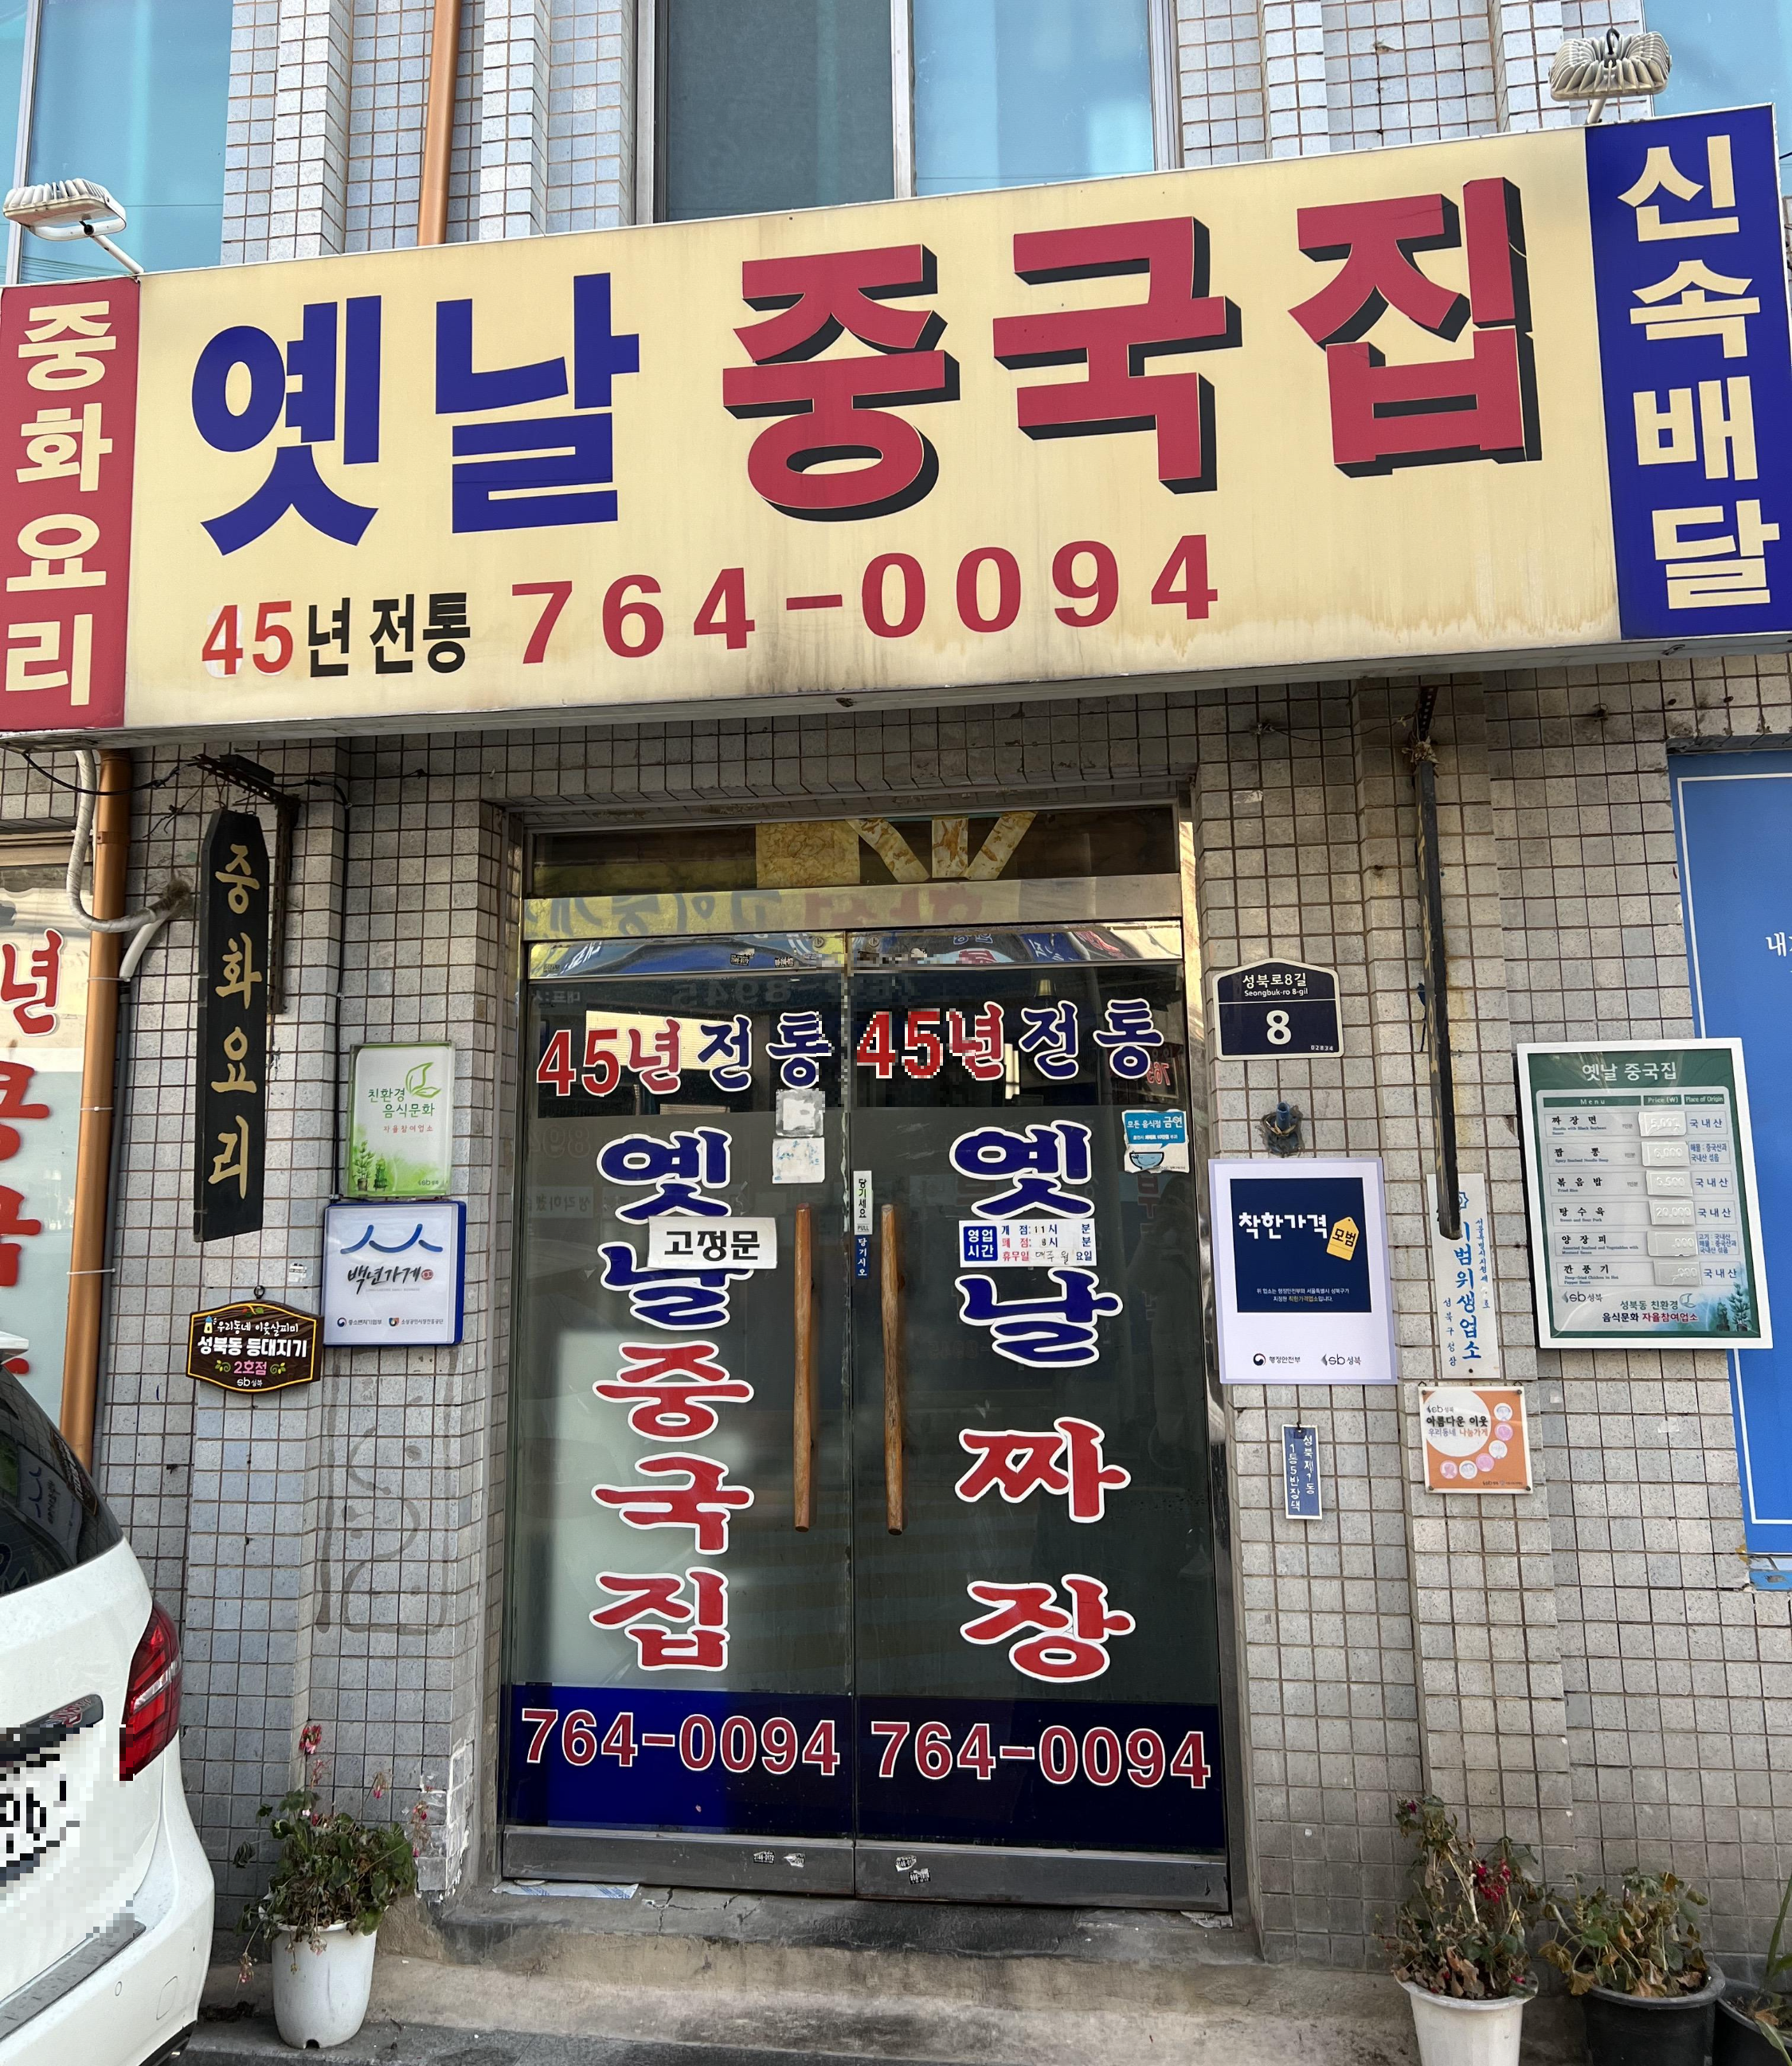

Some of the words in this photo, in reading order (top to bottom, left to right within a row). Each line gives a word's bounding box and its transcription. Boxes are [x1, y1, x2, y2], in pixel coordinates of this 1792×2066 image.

[191, 272, 640, 556] 옛날
[723, 177, 1542, 522] 중국집
[1617, 135, 1779, 608] 신속배달
[6, 300, 117, 706] 중화요리
[202, 597, 350, 678] 45년
[372, 592, 471, 675] 전통
[512, 534, 1218, 663] 764-0094
[1765, 932, 1792, 957] 내
[1242, 972, 1307, 989] 성북로8길
[208, 844, 264, 1199] 중화요리
[1266, 1010, 1292, 1045] 8
[857, 1000, 1005, 1082] 45년
[1019, 998, 1165, 1080] 전통
[535, 1017, 681, 1097] 45년
[697, 1011, 833, 1093] 전통
[1583, 1063, 1618, 1082] 옛날
[1624, 1062, 1677, 1080] 중국집
[368, 1088, 405, 1103] 친환경
[382, 1103, 435, 1119] 음식문화
[1127, 1120, 1141, 1129] 모든
[1142, 1120, 1161, 1129] 음식점
[1163, 1116, 1183, 1129] 금연
[1551, 1115, 1597, 1125] 짜장면
[1690, 1119, 1722, 1128] 국내산
[383, 1124, 434, 1133] 자율참여업소
[1557, 1177, 1602, 1187] 볶음밥
[1695, 1178, 1728, 1188] 국내산
[859, 1179, 867, 1218] 당기세요
[1559, 1207, 1605, 1216] 탕수육
[1697, 1208, 1731, 1218] 국내산
[597, 1126, 754, 1331] 옛날
[1082, 1224, 1091, 1234] 분
[1238, 1211, 1328, 1239] 착한가격
[968, 1229, 993, 1242] 영업
[1082, 1237, 1091, 1247] 분
[1332, 1228, 1357, 1247] 모범
[1562, 1235, 1606, 1244] 양장피
[664, 1230, 761, 1262] 고정문
[949, 1120, 1124, 1368] 옛날
[968, 1245, 994, 1258] 시간
[858, 1237, 867, 1276] 당기시오
[1003, 1251, 1029, 1262] 휴무일
[1035, 1250, 1054, 1262] 매주
[1060, 1251, 1069, 1265] 월
[1076, 1250, 1093, 1261] 요일
[1564, 1265, 1609, 1274] 깐풍기
[1704, 1269, 1736, 1278] 국내산
[347, 1265, 421, 1294] 백년가게
[1569, 1291, 1586, 1302] sb
[1587, 1293, 1602, 1302] 성북
[1620, 1301, 1647, 1310] 성북동
[1650, 1300, 1678, 1310] 친환경
[1602, 1313, 1639, 1322] 음식문화
[1642, 1313, 1698, 1322] 자율참여업소
[217, 1320, 251, 1334] 우리동네
[256, 1321, 299, 1336] 이웃살피미
[198, 1336, 242, 1356] 성북동
[246, 1337, 307, 1357] 등대지기
[1328, 1353, 1345, 1365] sb
[1347, 1356, 1361, 1365] 성북
[233, 1360, 268, 1375] 2호점
[237, 1376, 250, 1387] sb
[1426, 1415, 1465, 1427] 아름다운
[1469, 1415, 1488, 1427] 이웃
[1429, 1428, 1456, 1437] 우리동네
[1460, 1428, 1488, 1437] 나눔가게
[1303, 1435, 1315, 1494] 성북제1동
[589, 1340, 755, 1672] 중국집
[954, 1416, 1137, 1682] 짜장
[521, 1708, 839, 1776] 764-0094
[871, 1721, 1211, 1790] 764-0094
